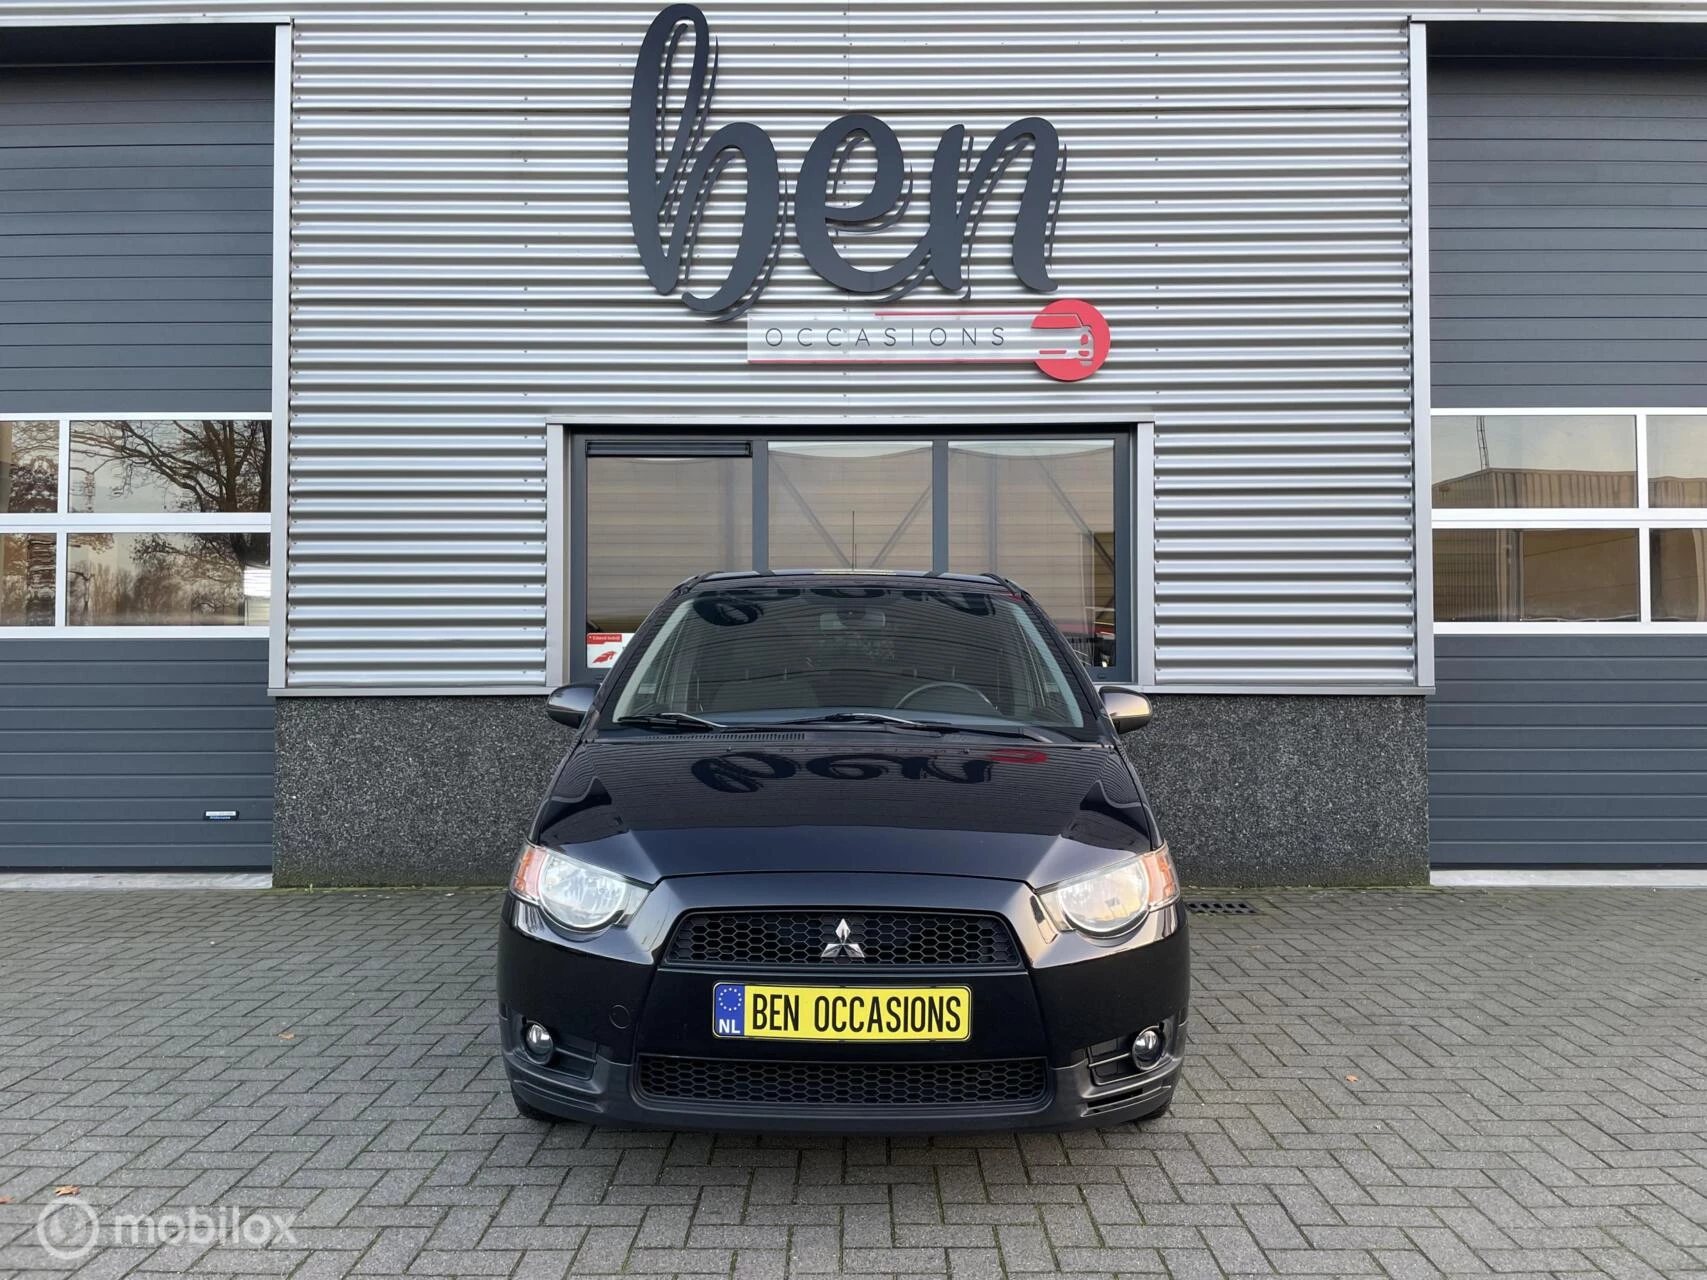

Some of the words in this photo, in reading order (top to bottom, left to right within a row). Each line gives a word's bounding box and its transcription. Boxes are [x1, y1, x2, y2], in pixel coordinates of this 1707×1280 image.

[627, 3, 1060, 313] ben
[765, 325, 1007, 347] OCCASIONS
[718, 1019, 741, 1034] NL
[752, 993, 800, 1031] BEN
[814, 995, 961, 1033] OCCASIONS
